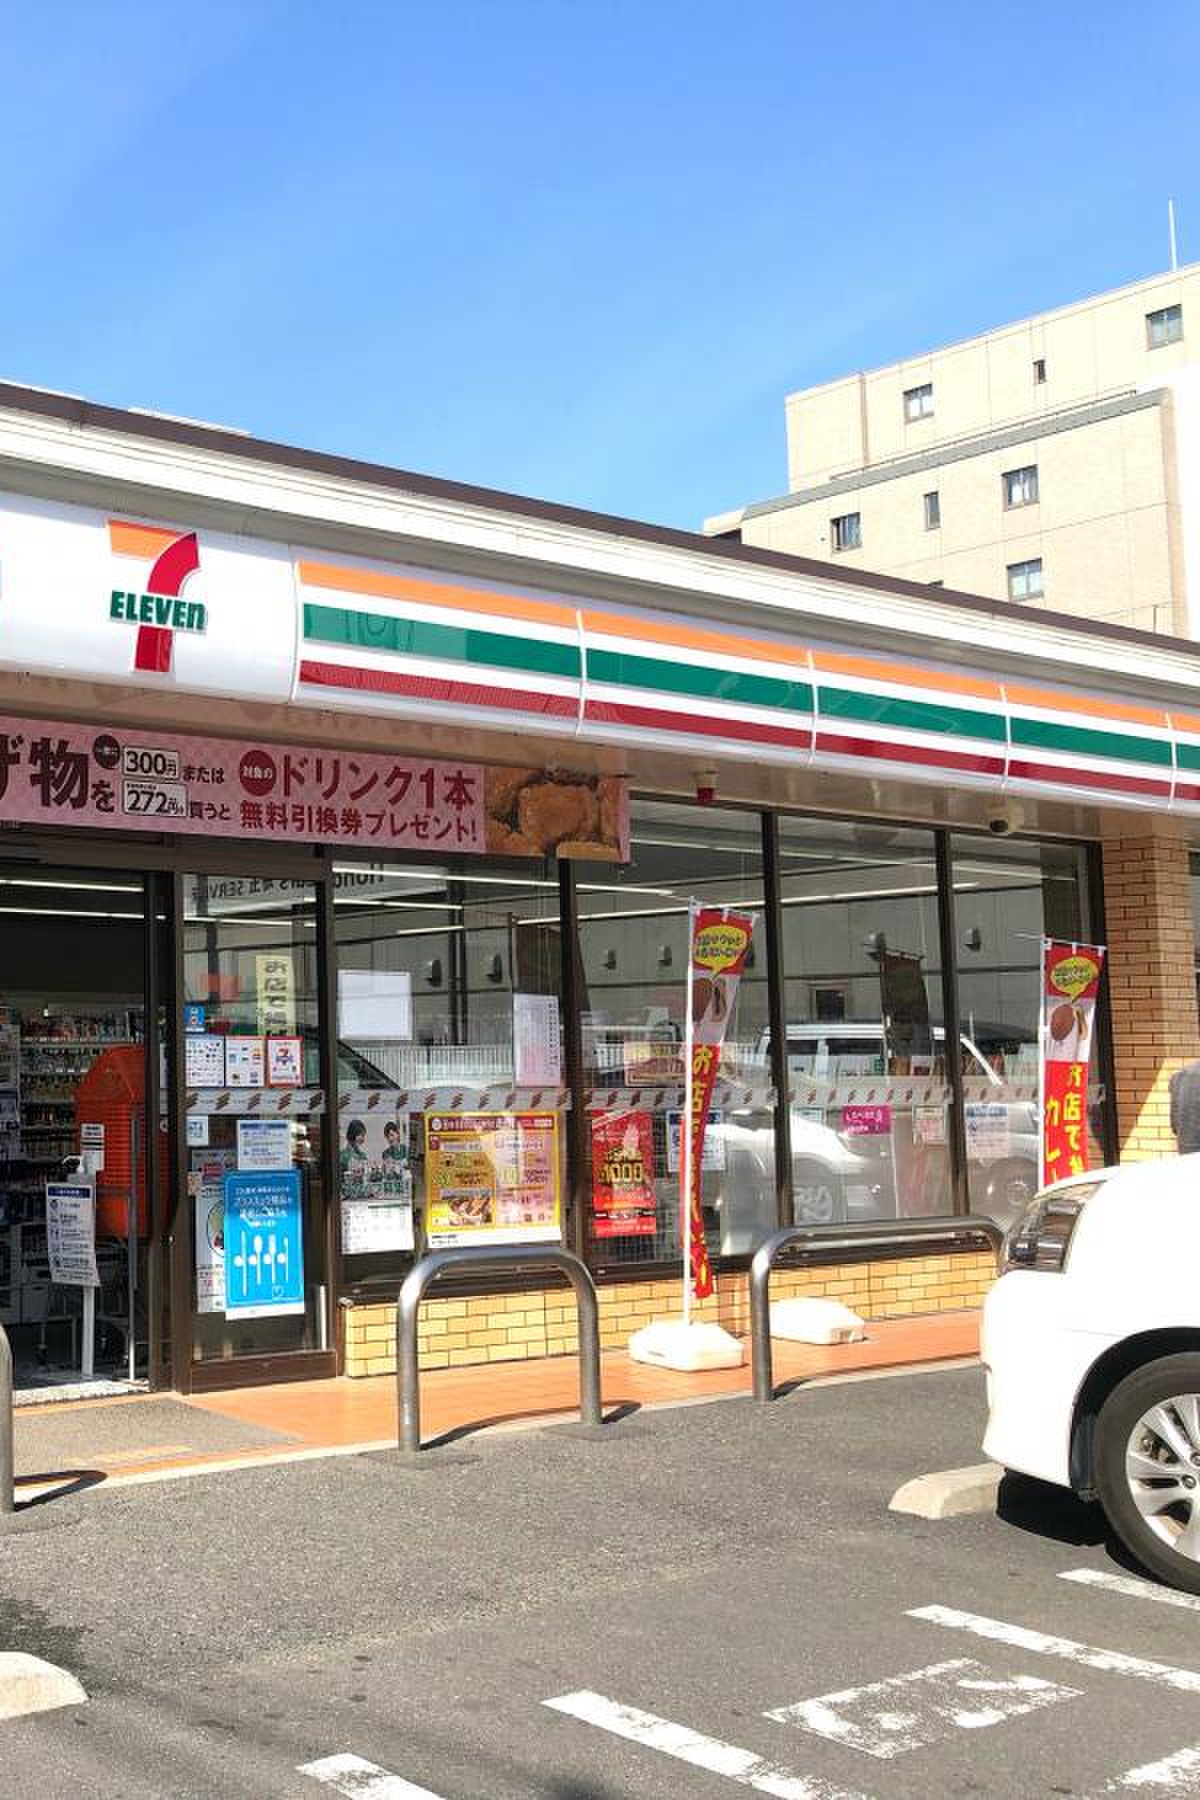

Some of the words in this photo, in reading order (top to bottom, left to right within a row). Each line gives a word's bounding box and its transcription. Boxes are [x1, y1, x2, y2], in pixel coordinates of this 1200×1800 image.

[182, 764, 225, 784] または
[283, 754, 476, 811] ドリンク1本
[189, 800, 232, 820] 買うと
[239, 799, 478, 842] 無料引換券プレゼント!
